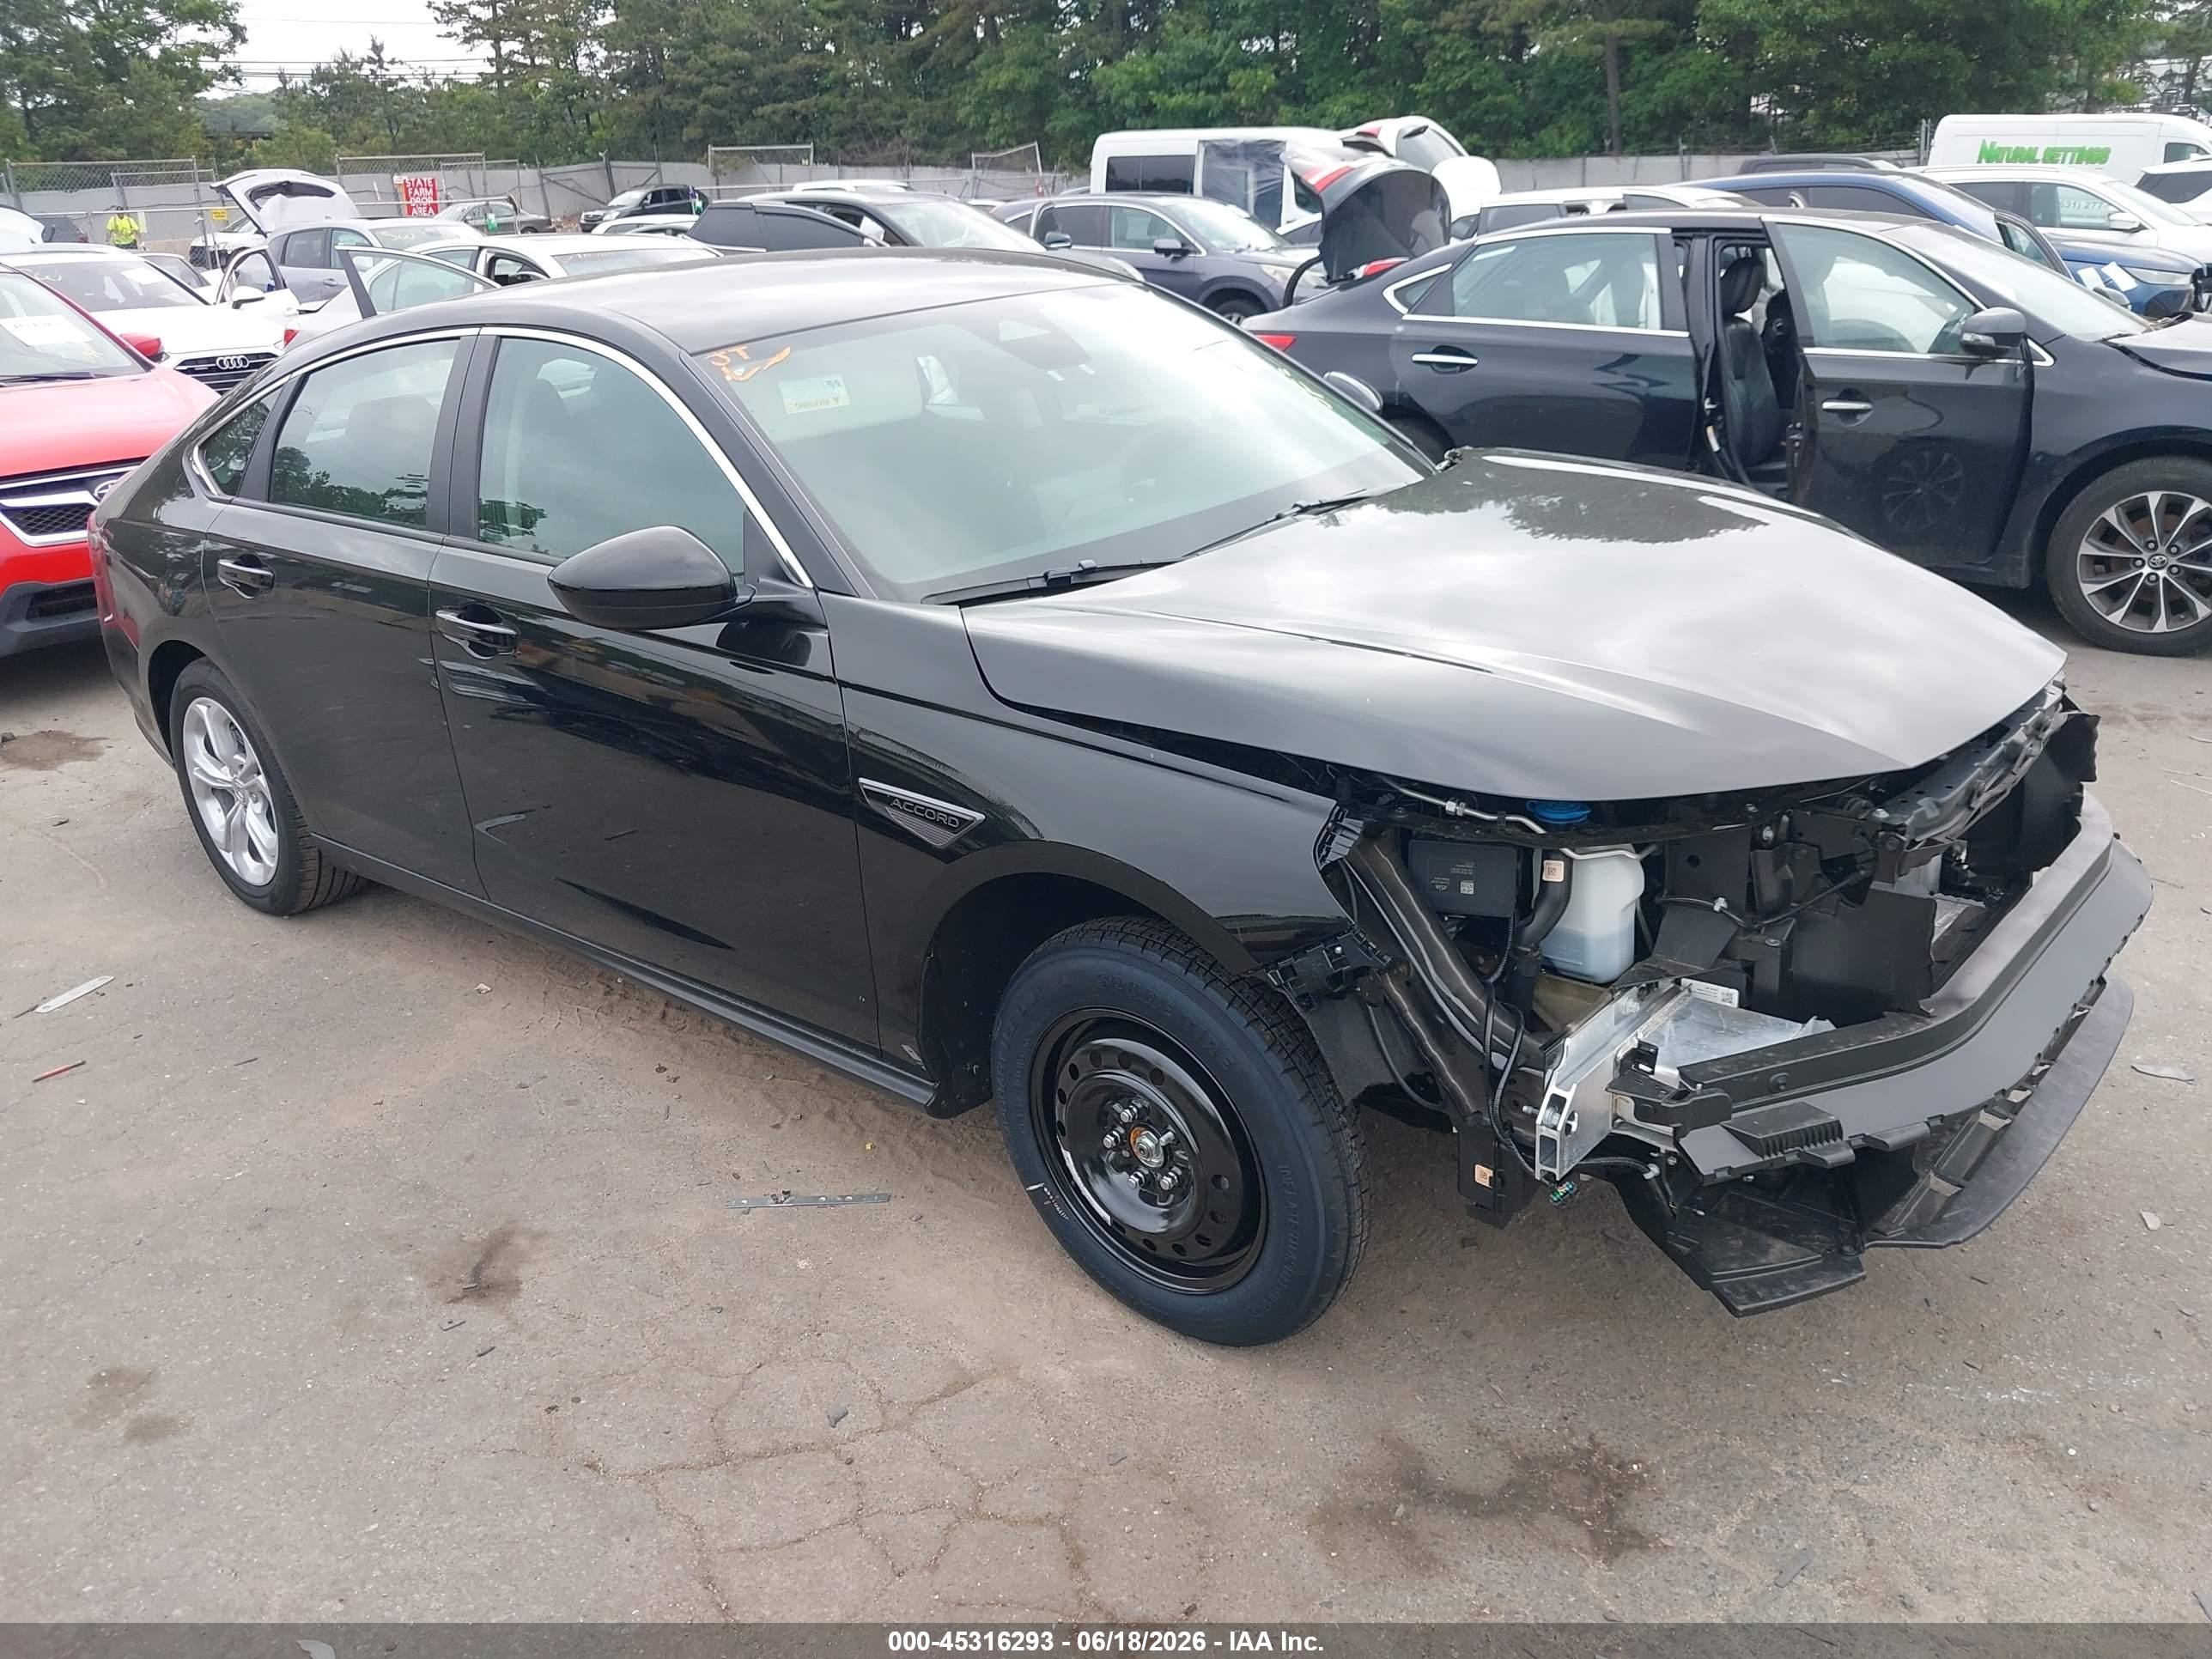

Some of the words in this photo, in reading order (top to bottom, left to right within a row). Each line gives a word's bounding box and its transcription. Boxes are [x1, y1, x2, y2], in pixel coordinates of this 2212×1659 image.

[405, 178, 433, 187] STATE
[408, 188, 433, 198] FARM
[410, 198, 433, 207] DROP
[411, 207, 434, 216] AREA
[890, 798, 960, 828] ACCORD
